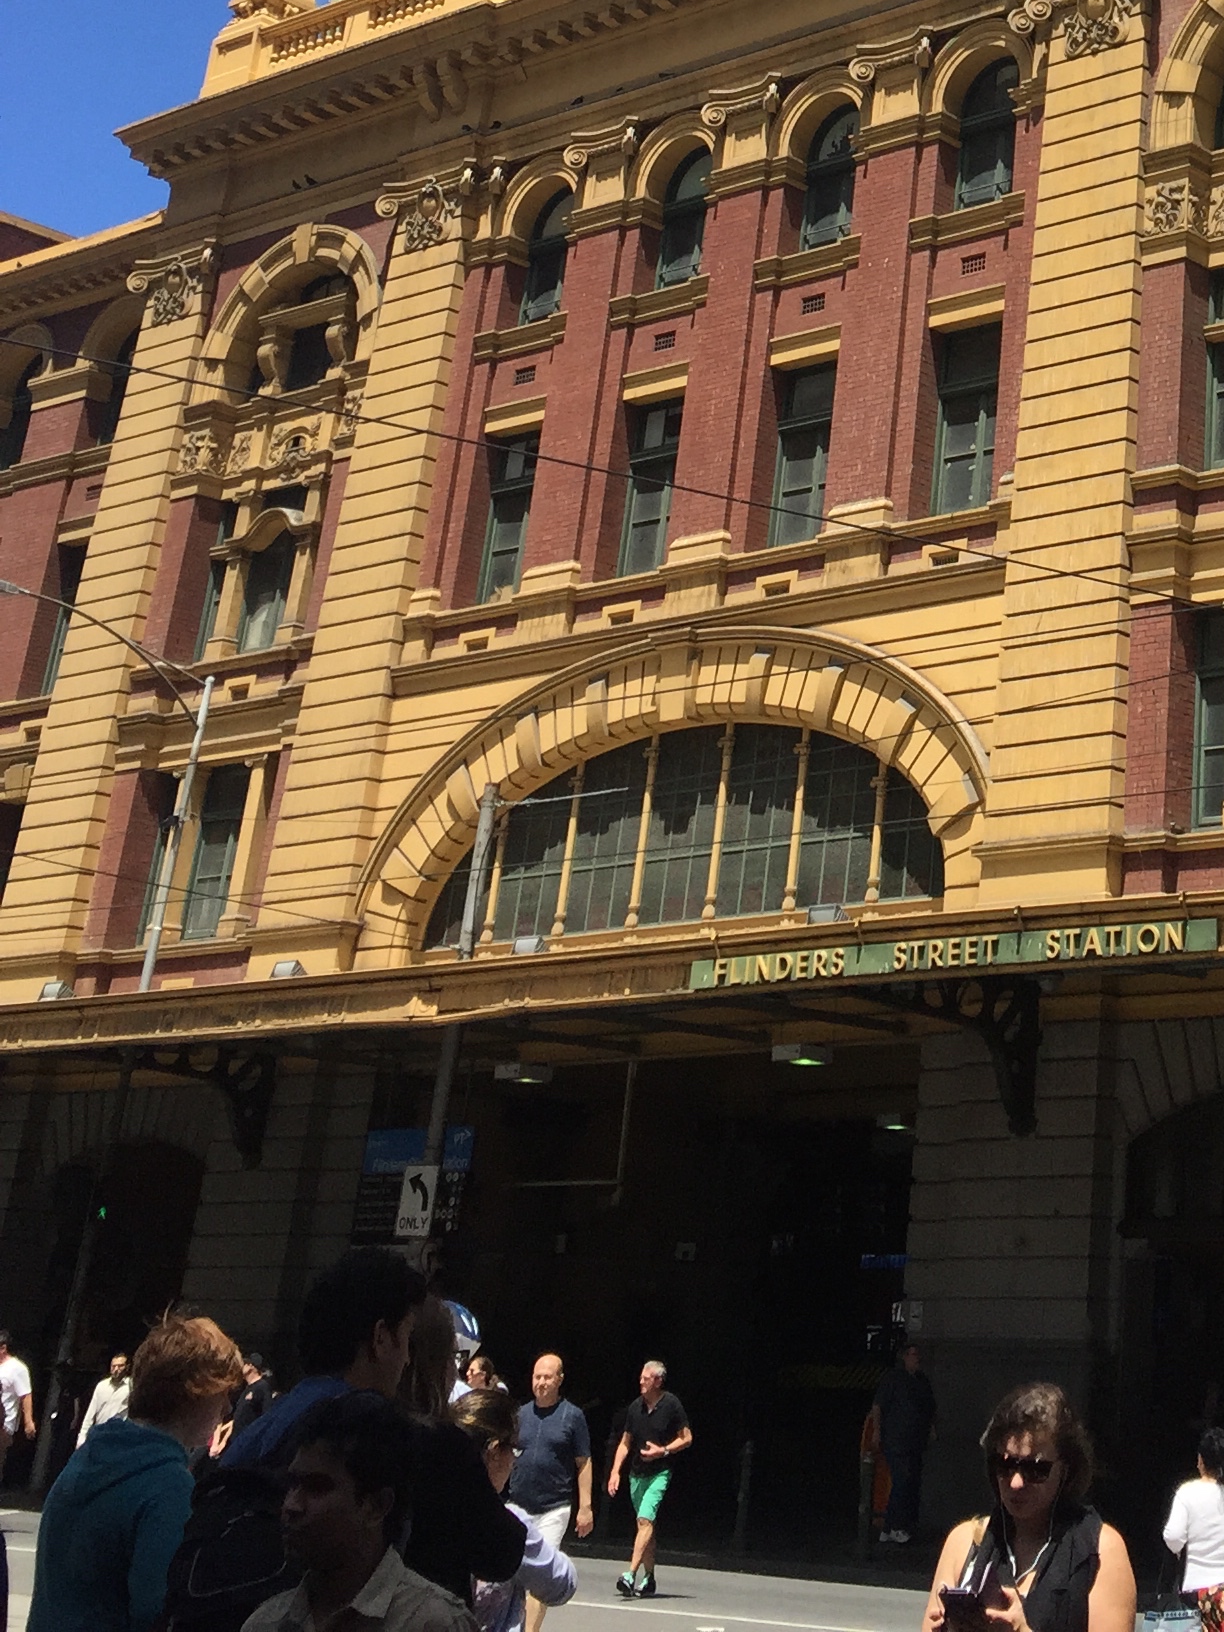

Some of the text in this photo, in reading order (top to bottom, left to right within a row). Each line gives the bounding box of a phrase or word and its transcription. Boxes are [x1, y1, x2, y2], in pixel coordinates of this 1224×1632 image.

[713, 922, 1184, 985] FLINDERS STREET STATION
[398, 1216, 429, 1230] ONLY
